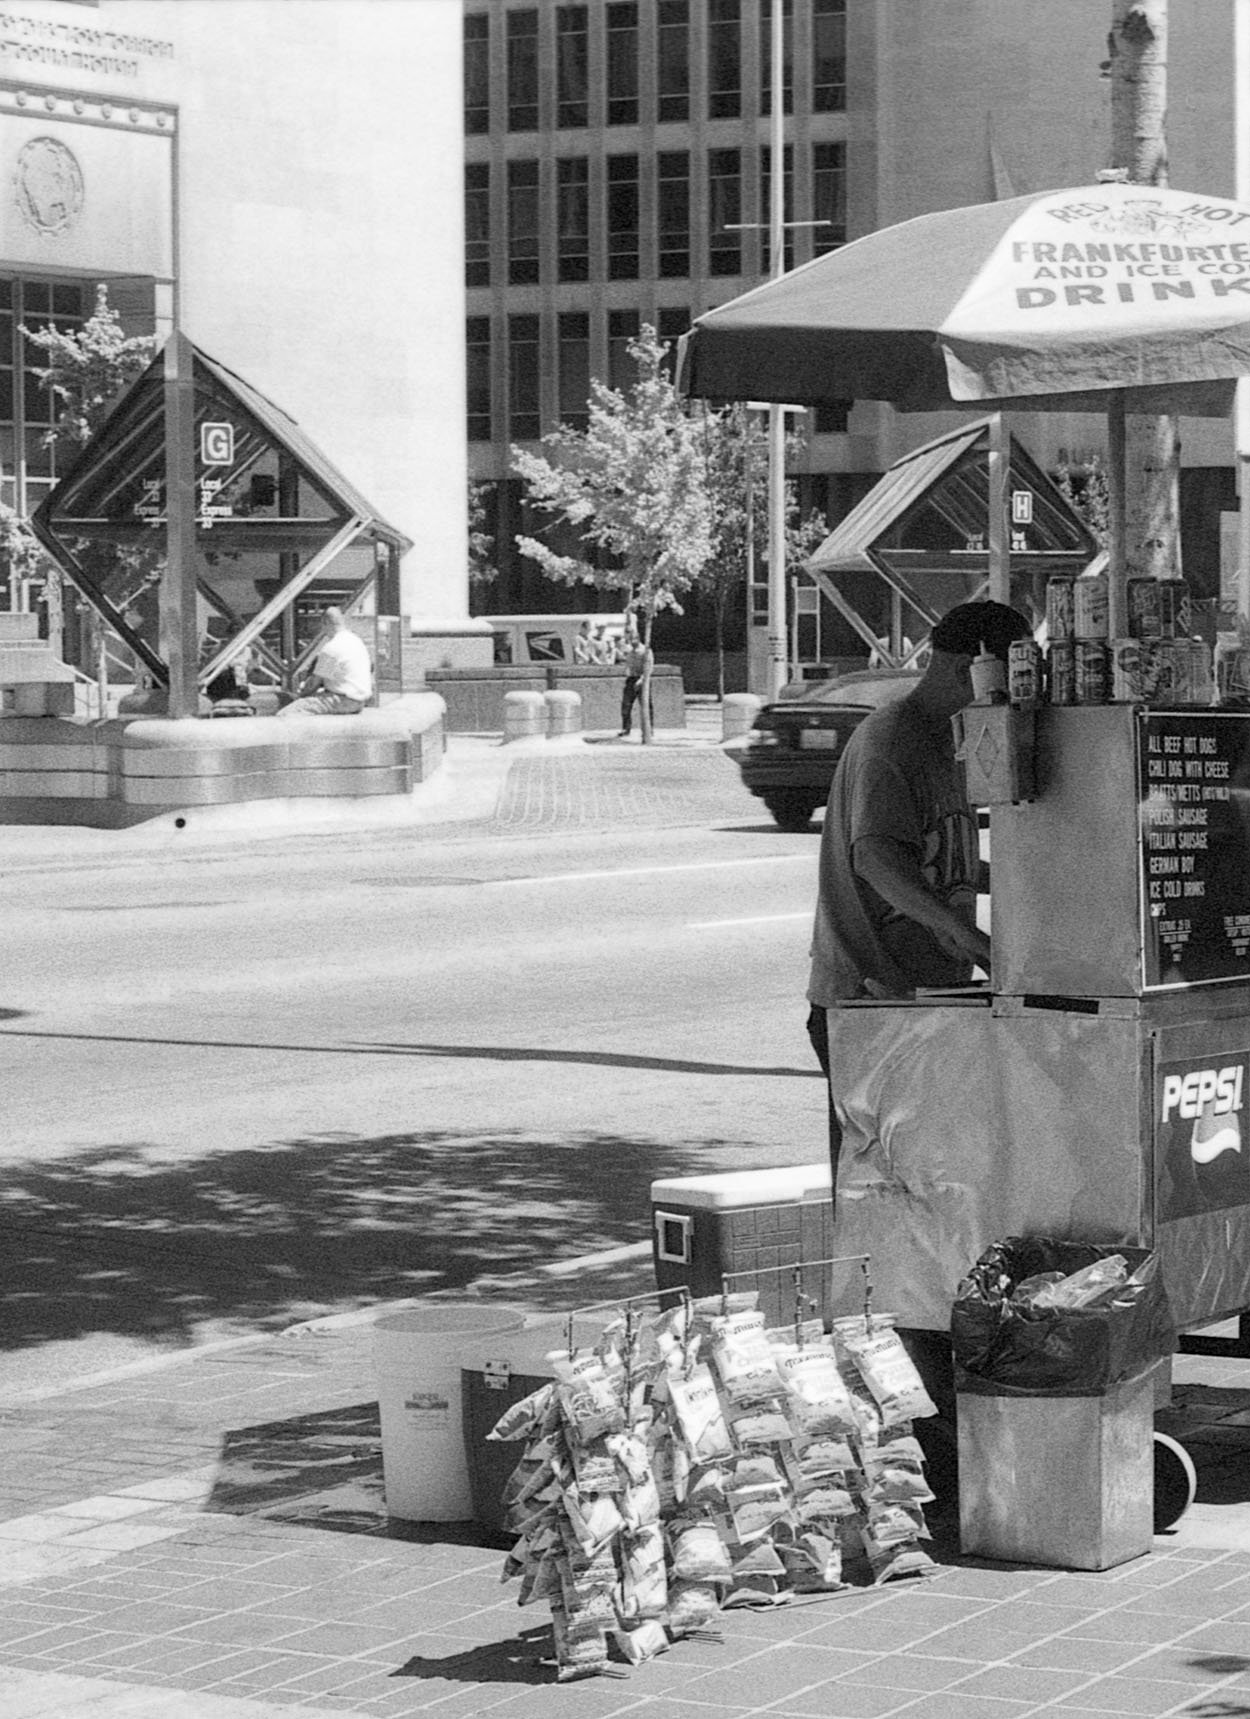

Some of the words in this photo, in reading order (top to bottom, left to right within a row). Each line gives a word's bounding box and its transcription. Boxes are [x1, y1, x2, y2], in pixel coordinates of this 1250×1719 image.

[1046, 201, 1111, 224] RED
[1033, 264, 1109, 280] AND
[1126, 263, 1184, 277] ICE
[207, 428, 229, 459] G
[1016, 495, 1029, 519] H
[1148, 735, 1162, 753] ALL
[1163, 736, 1181, 754] BEEF
[1183, 736, 1197, 754] HOT
[1199, 737, 1217, 755] DOGS
[1148, 759, 1166, 778] CHILI
[1168, 760, 1183, 778] DOG
[1184, 761, 1203, 778] WITH
[1204, 761, 1230, 779] CHEESE
[1148, 808, 1175, 826] POLISH
[1178, 808, 1209, 826] SAUSAGE
[1149, 832, 1177, 850] ITALIAN
[1178, 831, 1209, 850] SAUSAGE
[1149, 856, 1179, 874] GERMAN
[1181, 856, 1195, 873] BOY
[1150, 881, 1162, 899] ICE
[1163, 880, 1181, 898] COLD
[1183, 881, 1206, 897] DRINKS
[1162, 1065, 1244, 1124] PEPSI
